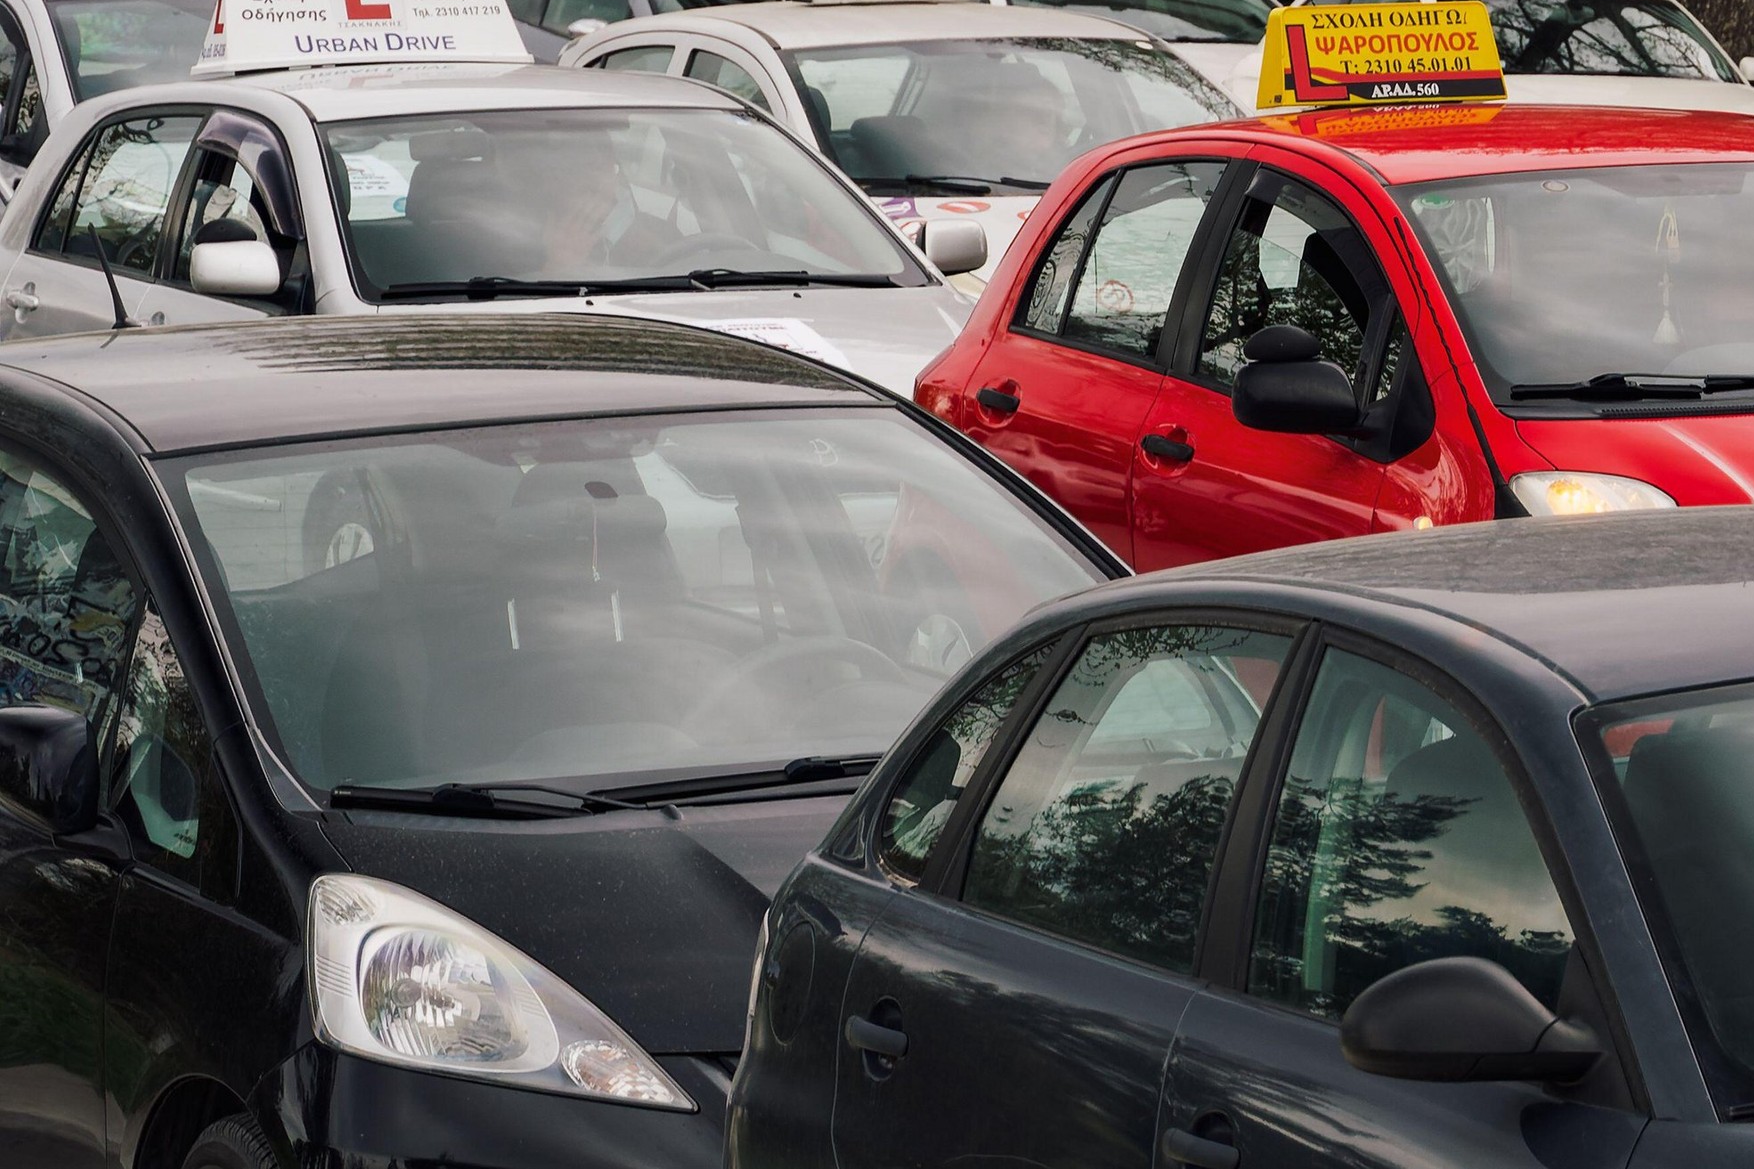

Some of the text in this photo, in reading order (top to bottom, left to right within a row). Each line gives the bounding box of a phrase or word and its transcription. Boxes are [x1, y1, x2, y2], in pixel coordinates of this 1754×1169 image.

[241, 7, 327, 22] Οδήγησης
[436, 7, 459, 17] 2310
[462, 6, 479, 16] 417
[483, 6, 501, 15] 219
[1311, 12, 1382, 29] ΣΧΟΛΗ
[295, 33, 456, 53] URBAN DRIVE
[1315, 32, 1480, 55] ΨΑΡΟΠΟΥΛΟΣ
[1286, 24, 1350, 102] L
[1365, 58, 1402, 73] 2310
[1408, 56, 1472, 72] 45.01.01
[1417, 83, 1440, 96] 560
